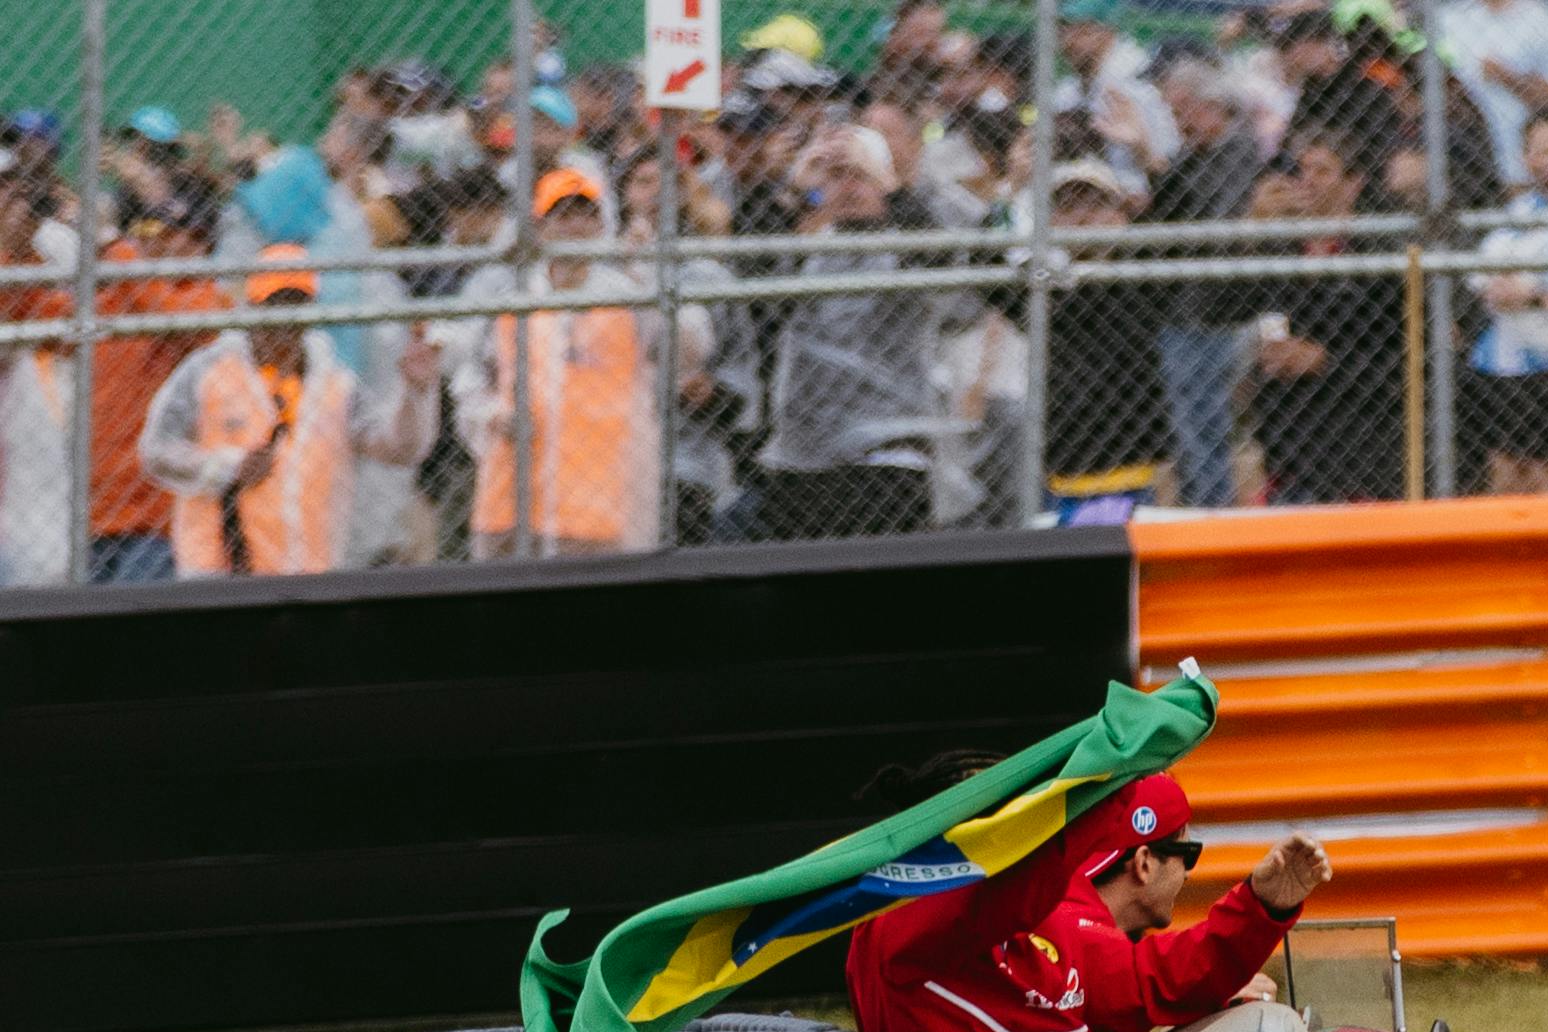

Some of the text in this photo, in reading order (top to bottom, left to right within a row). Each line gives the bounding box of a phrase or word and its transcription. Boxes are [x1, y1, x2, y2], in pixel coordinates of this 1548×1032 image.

[653, 26, 702, 46] FIRE
[1135, 808, 1155, 835] hp
[871, 863, 972, 881] GRESSO
